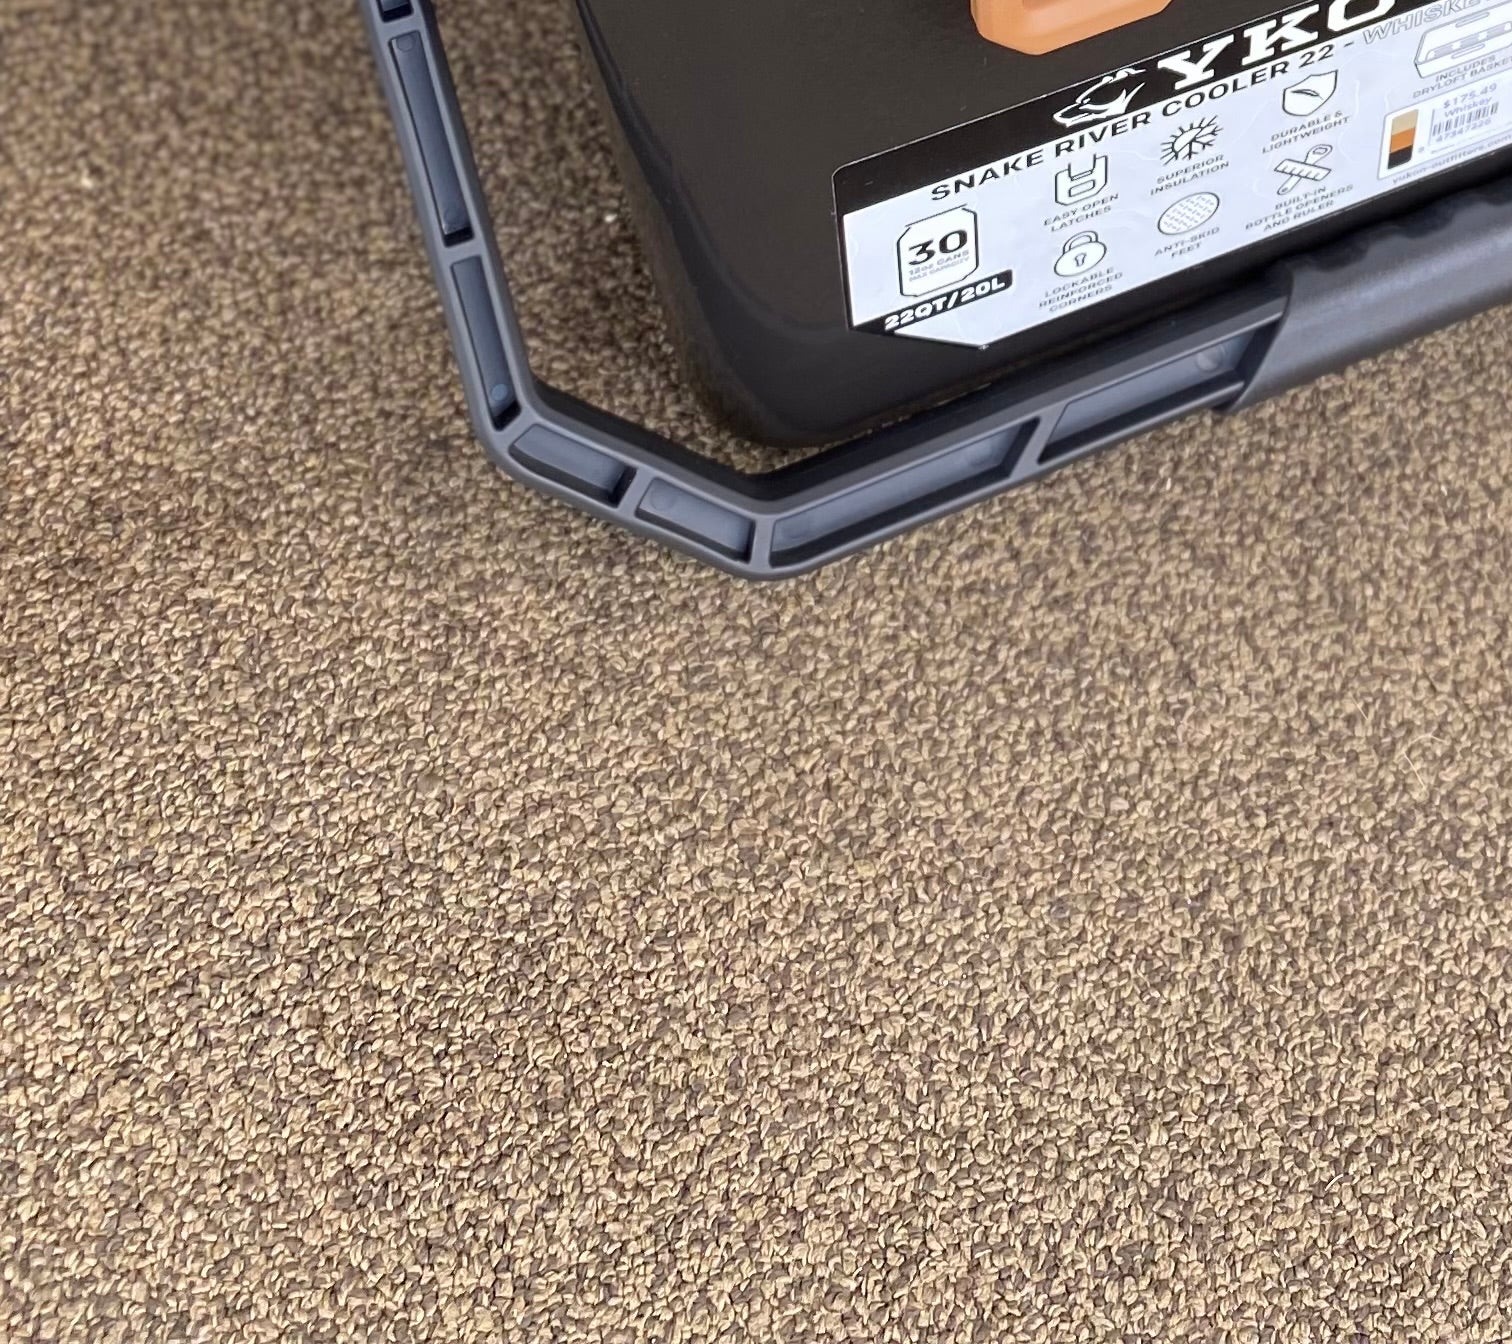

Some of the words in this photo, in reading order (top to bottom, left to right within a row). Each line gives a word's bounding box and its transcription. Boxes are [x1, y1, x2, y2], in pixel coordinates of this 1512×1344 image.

[1435, 55, 1497, 82] INCLUDES
[1412, 73, 1467, 98] DRYLOFT
[1442, 83, 1498, 109] $175.49
[931, 150, 1045, 202] SNAKE
[1055, 113, 1151, 158] RIVER
[1161, 59, 1290, 117] COOLER
[1298, 44, 1335, 70] 22
[1443, 97, 1493, 118] Whiskey
[1262, 116, 1351, 154] LIGHTWEIGHT
[1270, 114, 1331, 142] DURABLE
[1334, 110, 1344, 118] &
[1150, 161, 1230, 196] INSULATION
[1156, 154, 1225, 185] SUPERIOR
[1043, 208, 1077, 226] EASY
[1081, 193, 1120, 212] OPEN
[1245, 204, 1295, 230] BOTTLE
[1297, 184, 1354, 210] OPENERS
[1274, 186, 1327, 210] BUILT-IN
[1050, 205, 1112, 233] LATCHES
[1263, 216, 1291, 232] AND
[1293, 200, 1335, 221] RULER
[908, 229, 968, 266] 30
[936, 249, 970, 265] CANS
[1153, 226, 1220, 257] ANTI-SKID
[1170, 242, 1202, 259] FEET
[1038, 272, 1124, 309] REINFORCED
[1044, 267, 1114, 298] LOCKABLE
[1049, 284, 1113, 312] CORNERS
[884, 277, 1006, 332] 22QT/20L
